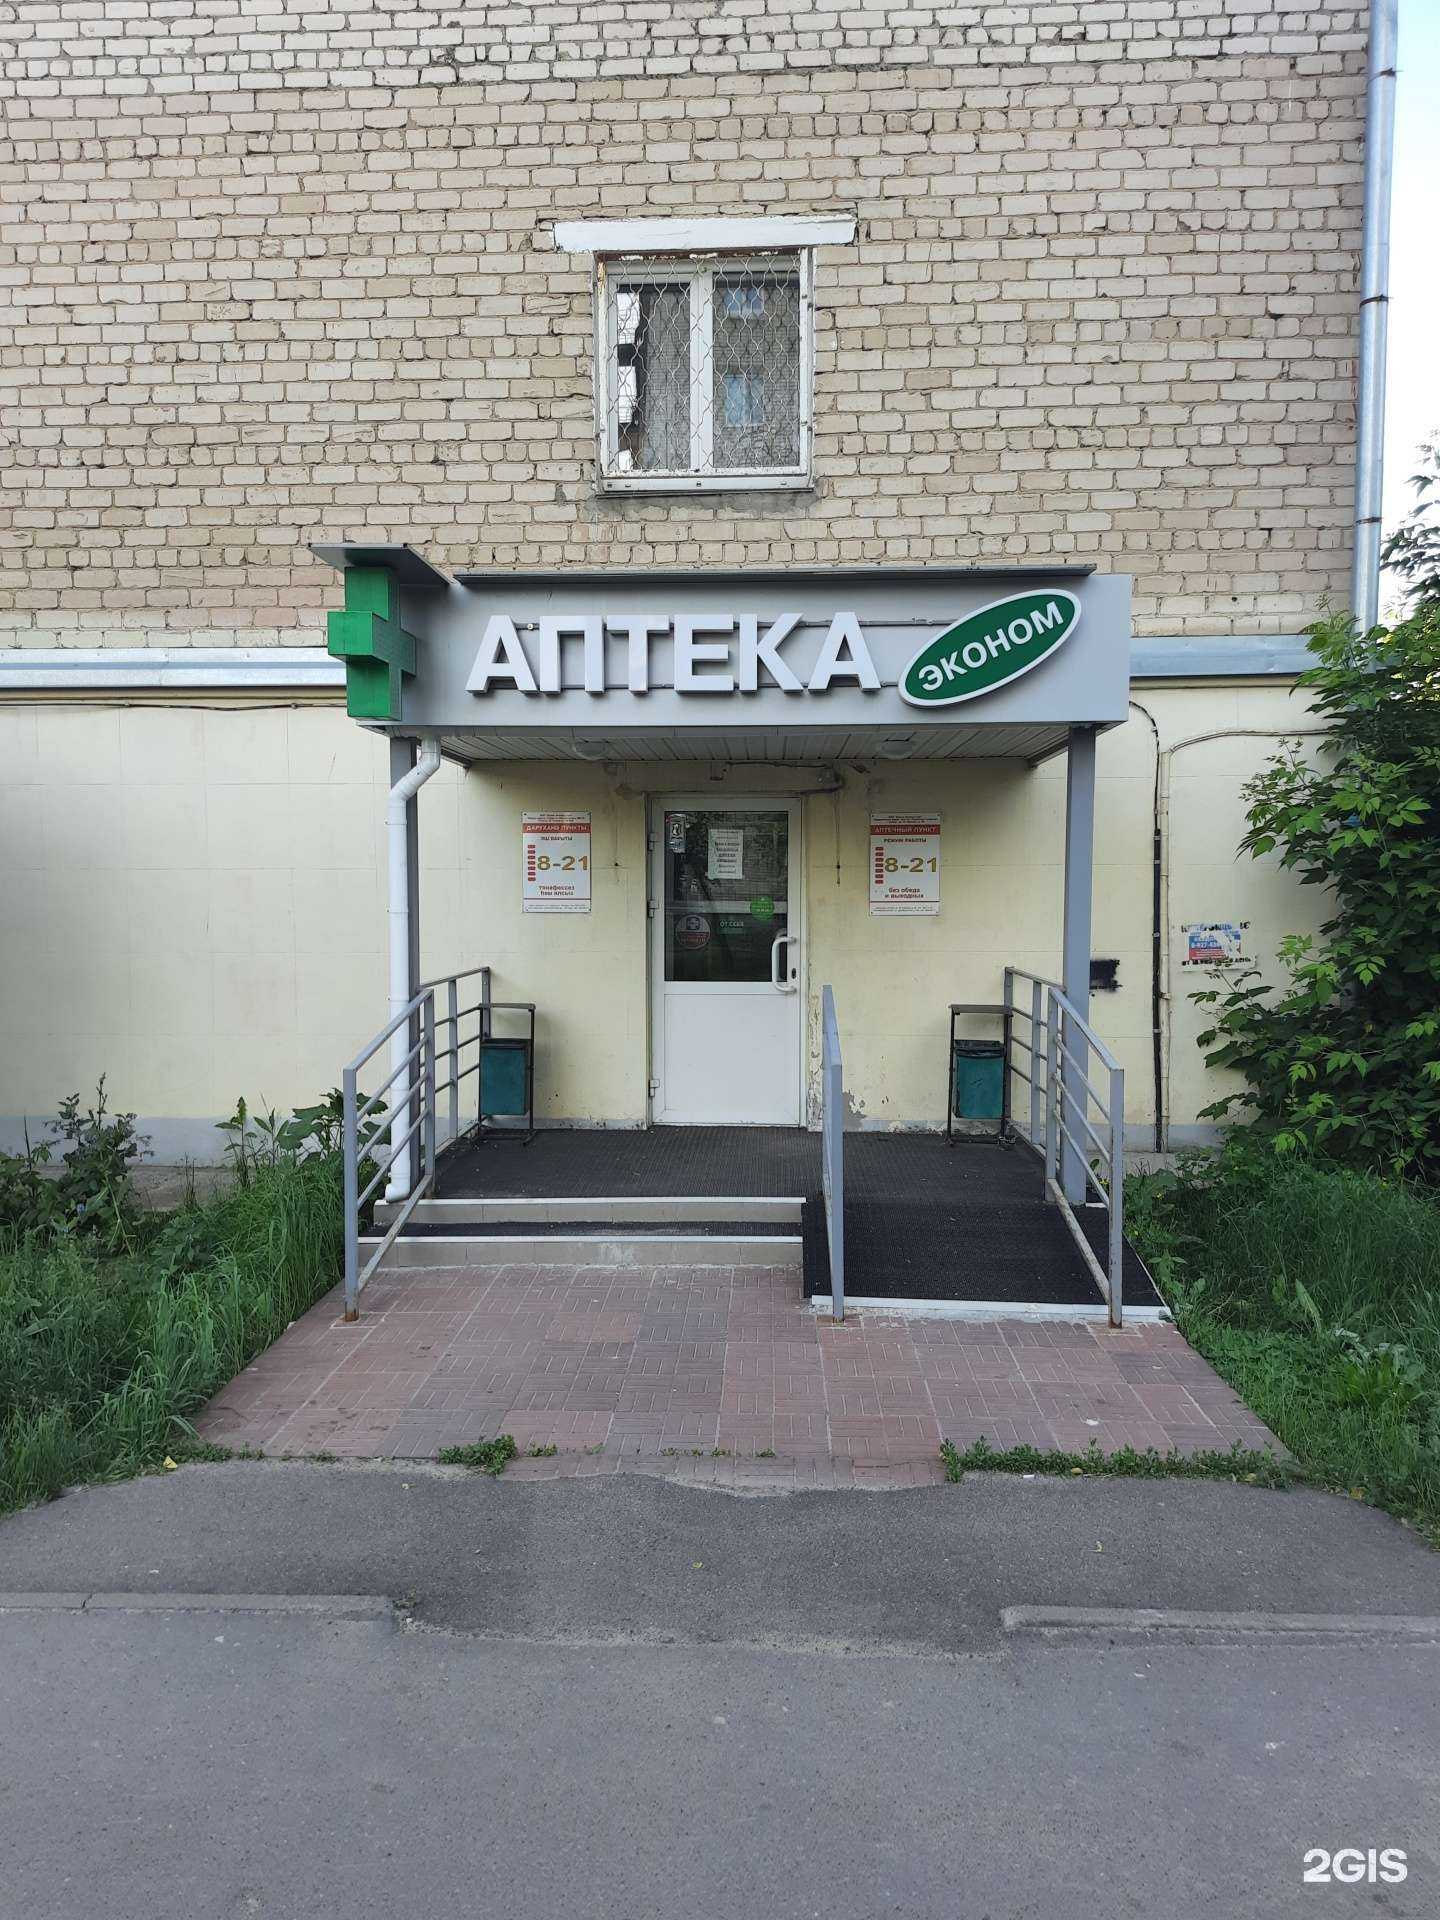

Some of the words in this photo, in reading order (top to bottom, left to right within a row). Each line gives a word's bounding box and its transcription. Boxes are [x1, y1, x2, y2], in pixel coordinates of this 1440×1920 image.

[466, 611, 882, 695] АПТЕКА
[917, 601, 1065, 693] ЭКОНОМ
[537, 855, 589, 871] 8-21
[884, 857, 937, 873] 8-21
